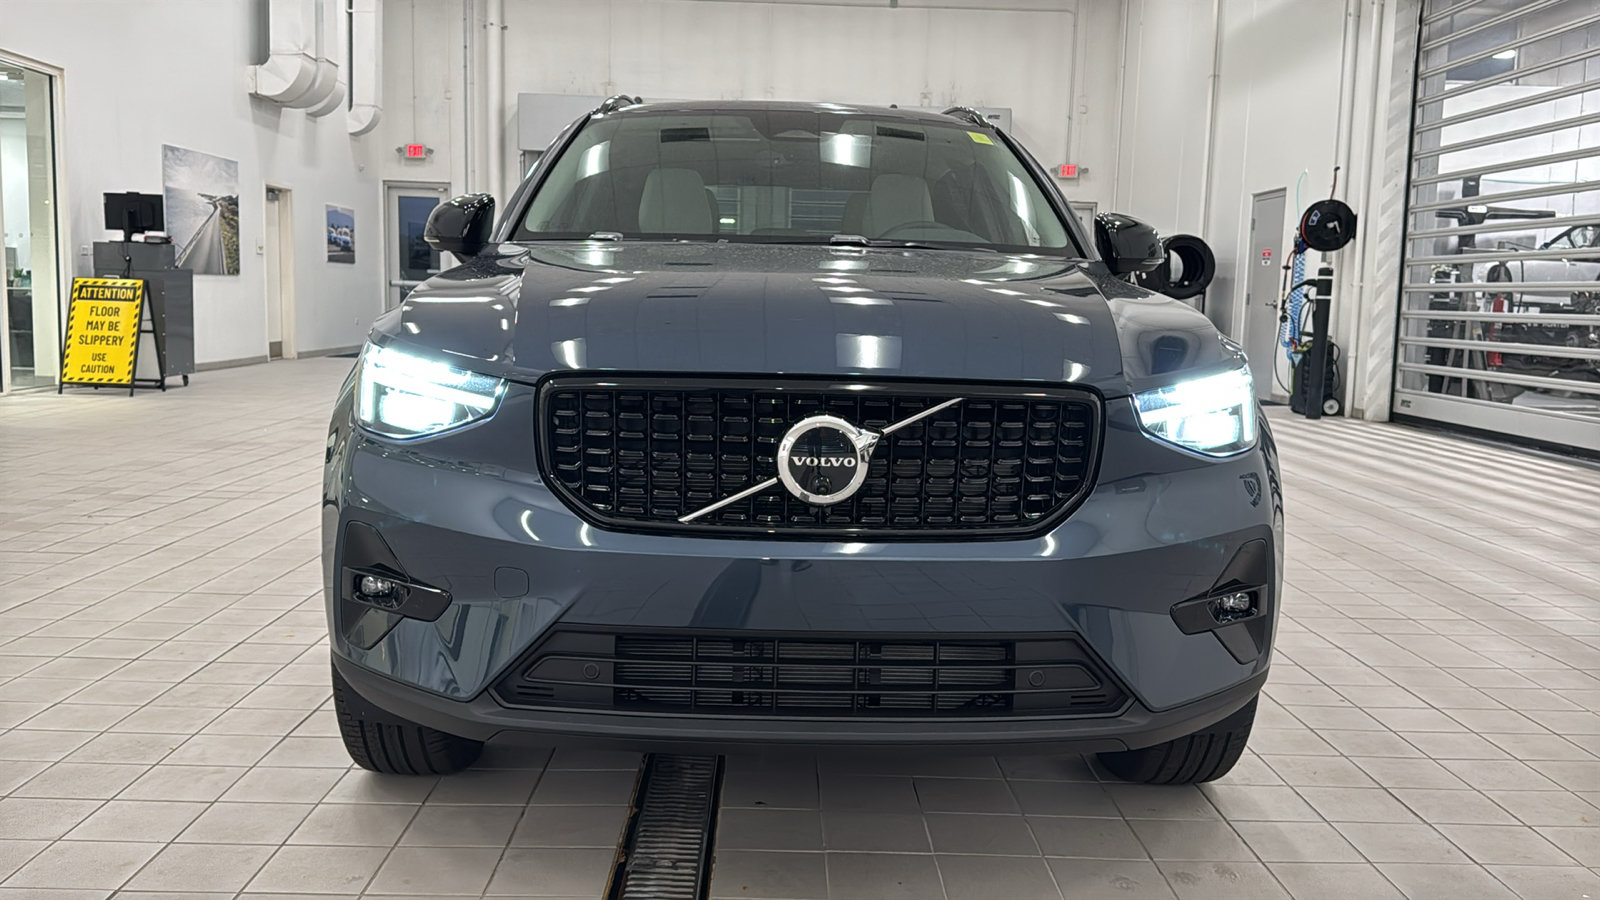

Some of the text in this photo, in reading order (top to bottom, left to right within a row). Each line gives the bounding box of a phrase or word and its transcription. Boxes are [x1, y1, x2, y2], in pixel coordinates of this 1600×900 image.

[80, 287, 134, 300] ATTENTION
[89, 306, 120, 317] FLOOR
[86, 320, 120, 331] MAY BE
[78, 335, 124, 346] SLIPPERY
[91, 353, 107, 362] USE
[81, 364, 115, 374] CAUTION
[791, 456, 856, 467] VOLVO
